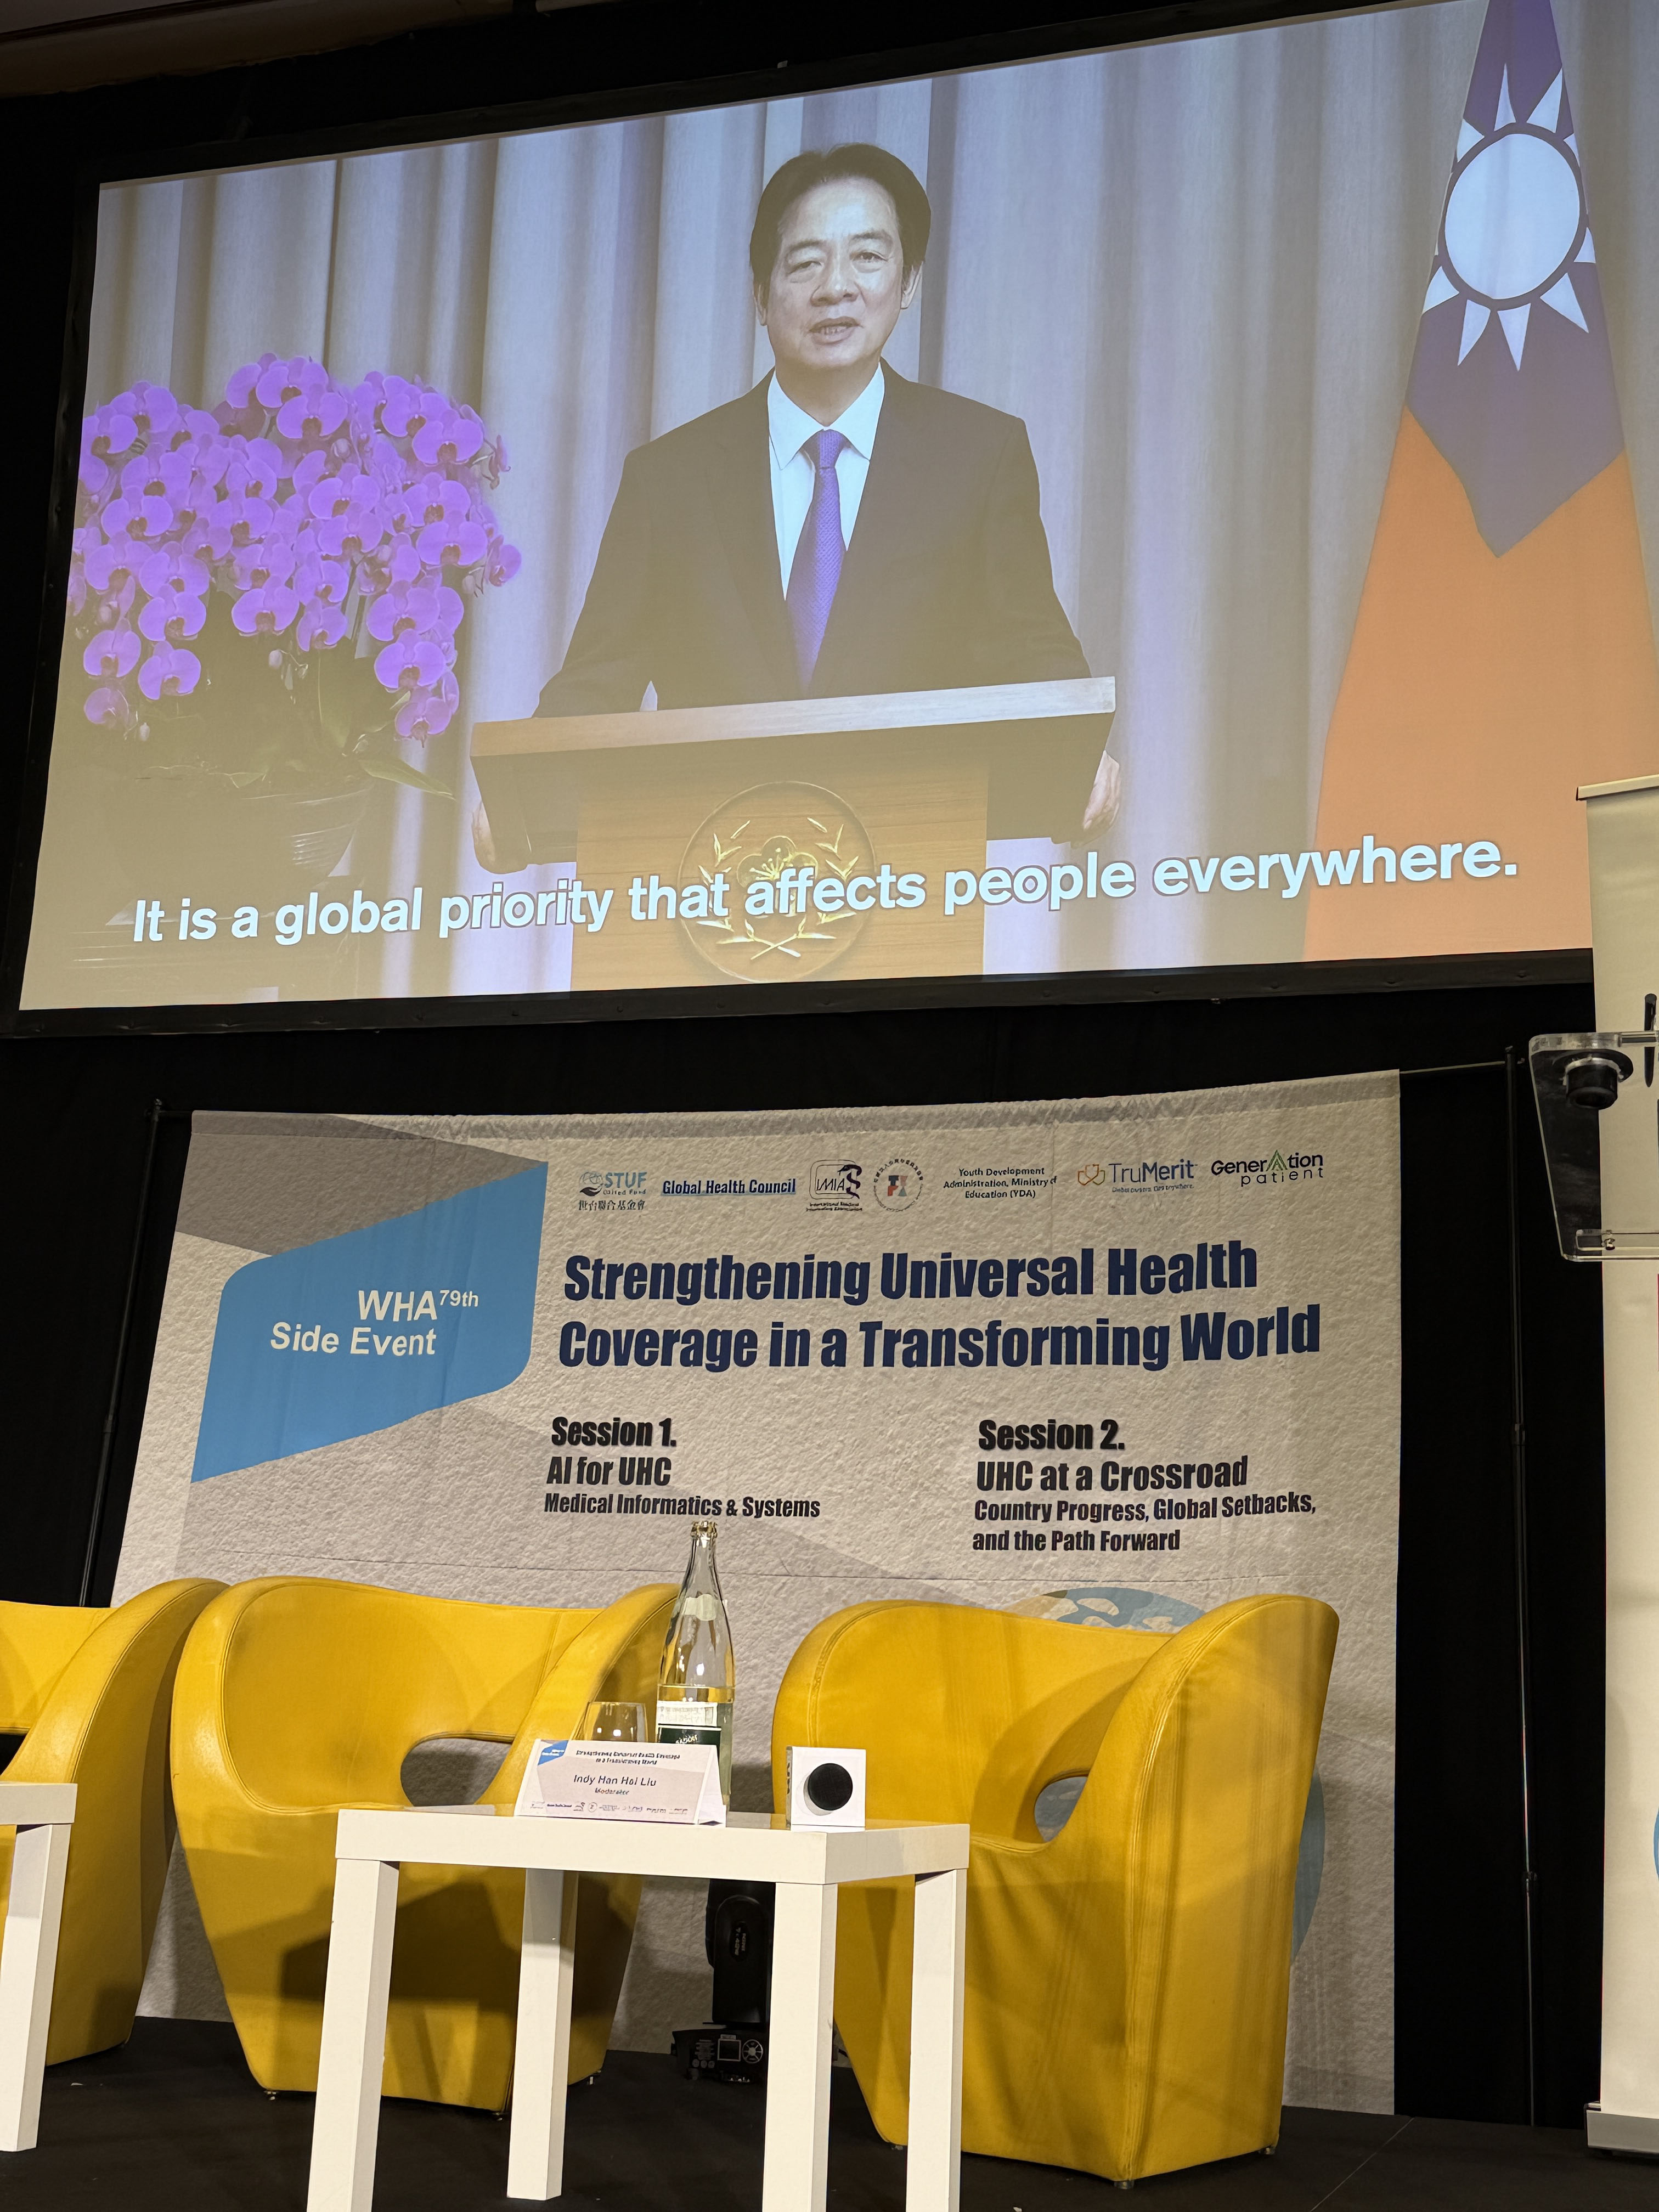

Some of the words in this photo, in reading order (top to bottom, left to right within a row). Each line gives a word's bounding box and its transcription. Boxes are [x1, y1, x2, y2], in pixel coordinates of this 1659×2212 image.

[133, 900, 165, 942] It
[178, 898, 217, 940] is
[230, 906, 258, 938] a
[274, 887, 424, 946] global
[439, 879, 613, 939] priority
[628, 874, 730, 921] that
[744, 864, 926, 915] affects
[945, 851, 1136, 916] people
[1153, 835, 1518, 899] everywhere.
[605, 1172, 647, 1188] STUF
[944, 1180, 1008, 1188] Administration,
[1012, 1178, 1048, 1188] Ministry
[959, 1168, 983, 1176] Youth
[986, 1167, 1045, 1176] Development
[1108, 1159, 1194, 1183] TruMerit
[1241, 1167, 1323, 1187] patient
[663, 1180, 701, 1194] Global
[706, 1180, 745, 1194] Health
[749, 1178, 795, 1193] Council
[1010, 1190, 1036, 1198] (YDA)
[565, 1254, 871, 1306] Strengthening
[881, 1248, 1094, 1300] Universal
[1108, 1240, 1257, 1295] Health
[358, 1290, 437, 1321] WHA
[439, 1290, 478, 1307] 79th
[270, 1322, 339, 1353] Side
[350, 1327, 437, 1356] Event
[558, 1321, 758, 1373] Coverage
[769, 1322, 810, 1367] in
[821, 1329, 848, 1368] a
[859, 1318, 1170, 1372] Transforming
[1180, 1304, 1321, 1361] World
[551, 1417, 653, 1447] Session
[659, 1418, 676, 1447] 1.
[978, 1419, 1093, 1450] Session
[1100, 1419, 1125, 1450] 2.
[546, 1457, 572, 1485] AI
[577, 1457, 613, 1485] for
[619, 1457, 672, 1486] UHC
[977, 1460, 1032, 1491] UHC
[1040, 1463, 1069, 1491] at
[1076, 1467, 1092, 1491] a
[1101, 1455, 1248, 1491] Crossroad
[544, 1493, 613, 1514] Medical
[617, 1494, 722, 1516] Informatics
[726, 1498, 738, 1515] &
[742, 1496, 821, 1518] Systems
[974, 1500, 1052, 1523] Country
[1057, 1500, 1149, 1522] Progress,
[1154, 1498, 1217, 1519] Global
[1222, 1491, 1316, 1517] Setbacks,
[973, 1530, 1009, 1550] and
[1014, 1530, 1046, 1550] the
[1051, 1531, 1095, 1550] Path
[1100, 1530, 1180, 1551] Forward
[574, 1775, 595, 1785] Indy
[598, 1775, 618, 1784] Han
